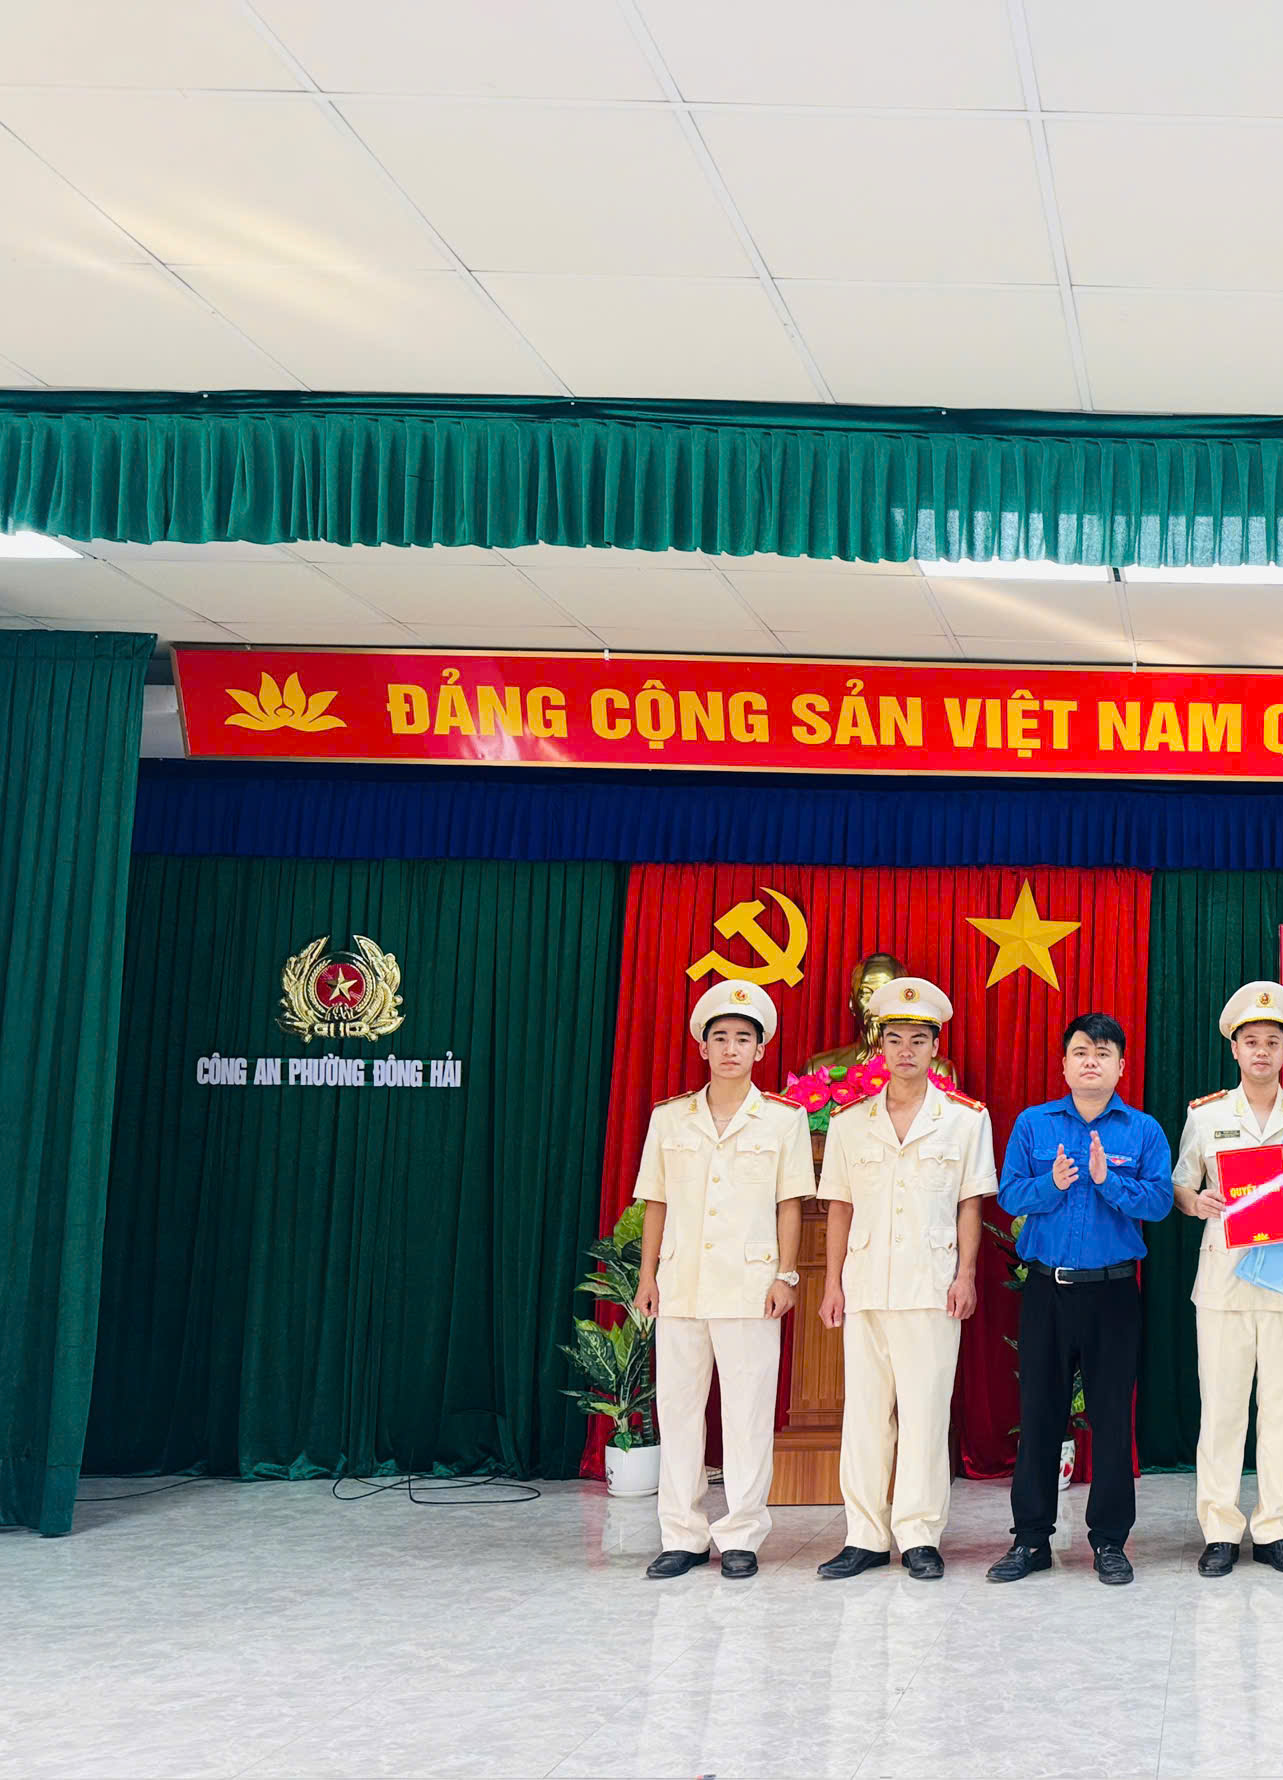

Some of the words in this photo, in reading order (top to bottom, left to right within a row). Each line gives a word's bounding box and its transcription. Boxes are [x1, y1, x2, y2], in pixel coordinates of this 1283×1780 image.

[387, 669, 568, 737] ĐẢNG
[591, 680, 770, 749] CỘNG
[792, 680, 923, 746] SẢN
[944, 690, 1078, 757] VIỆT
[1099, 702, 1242, 752] NAM
[197, 1053, 247, 1085] CÔNG
[254, 1058, 281, 1086] AN
[288, 1054, 365, 1087] PHƯỜNG
[373, 1055, 423, 1087] ĐÔNG
[430, 1051, 461, 1088] HẢI
